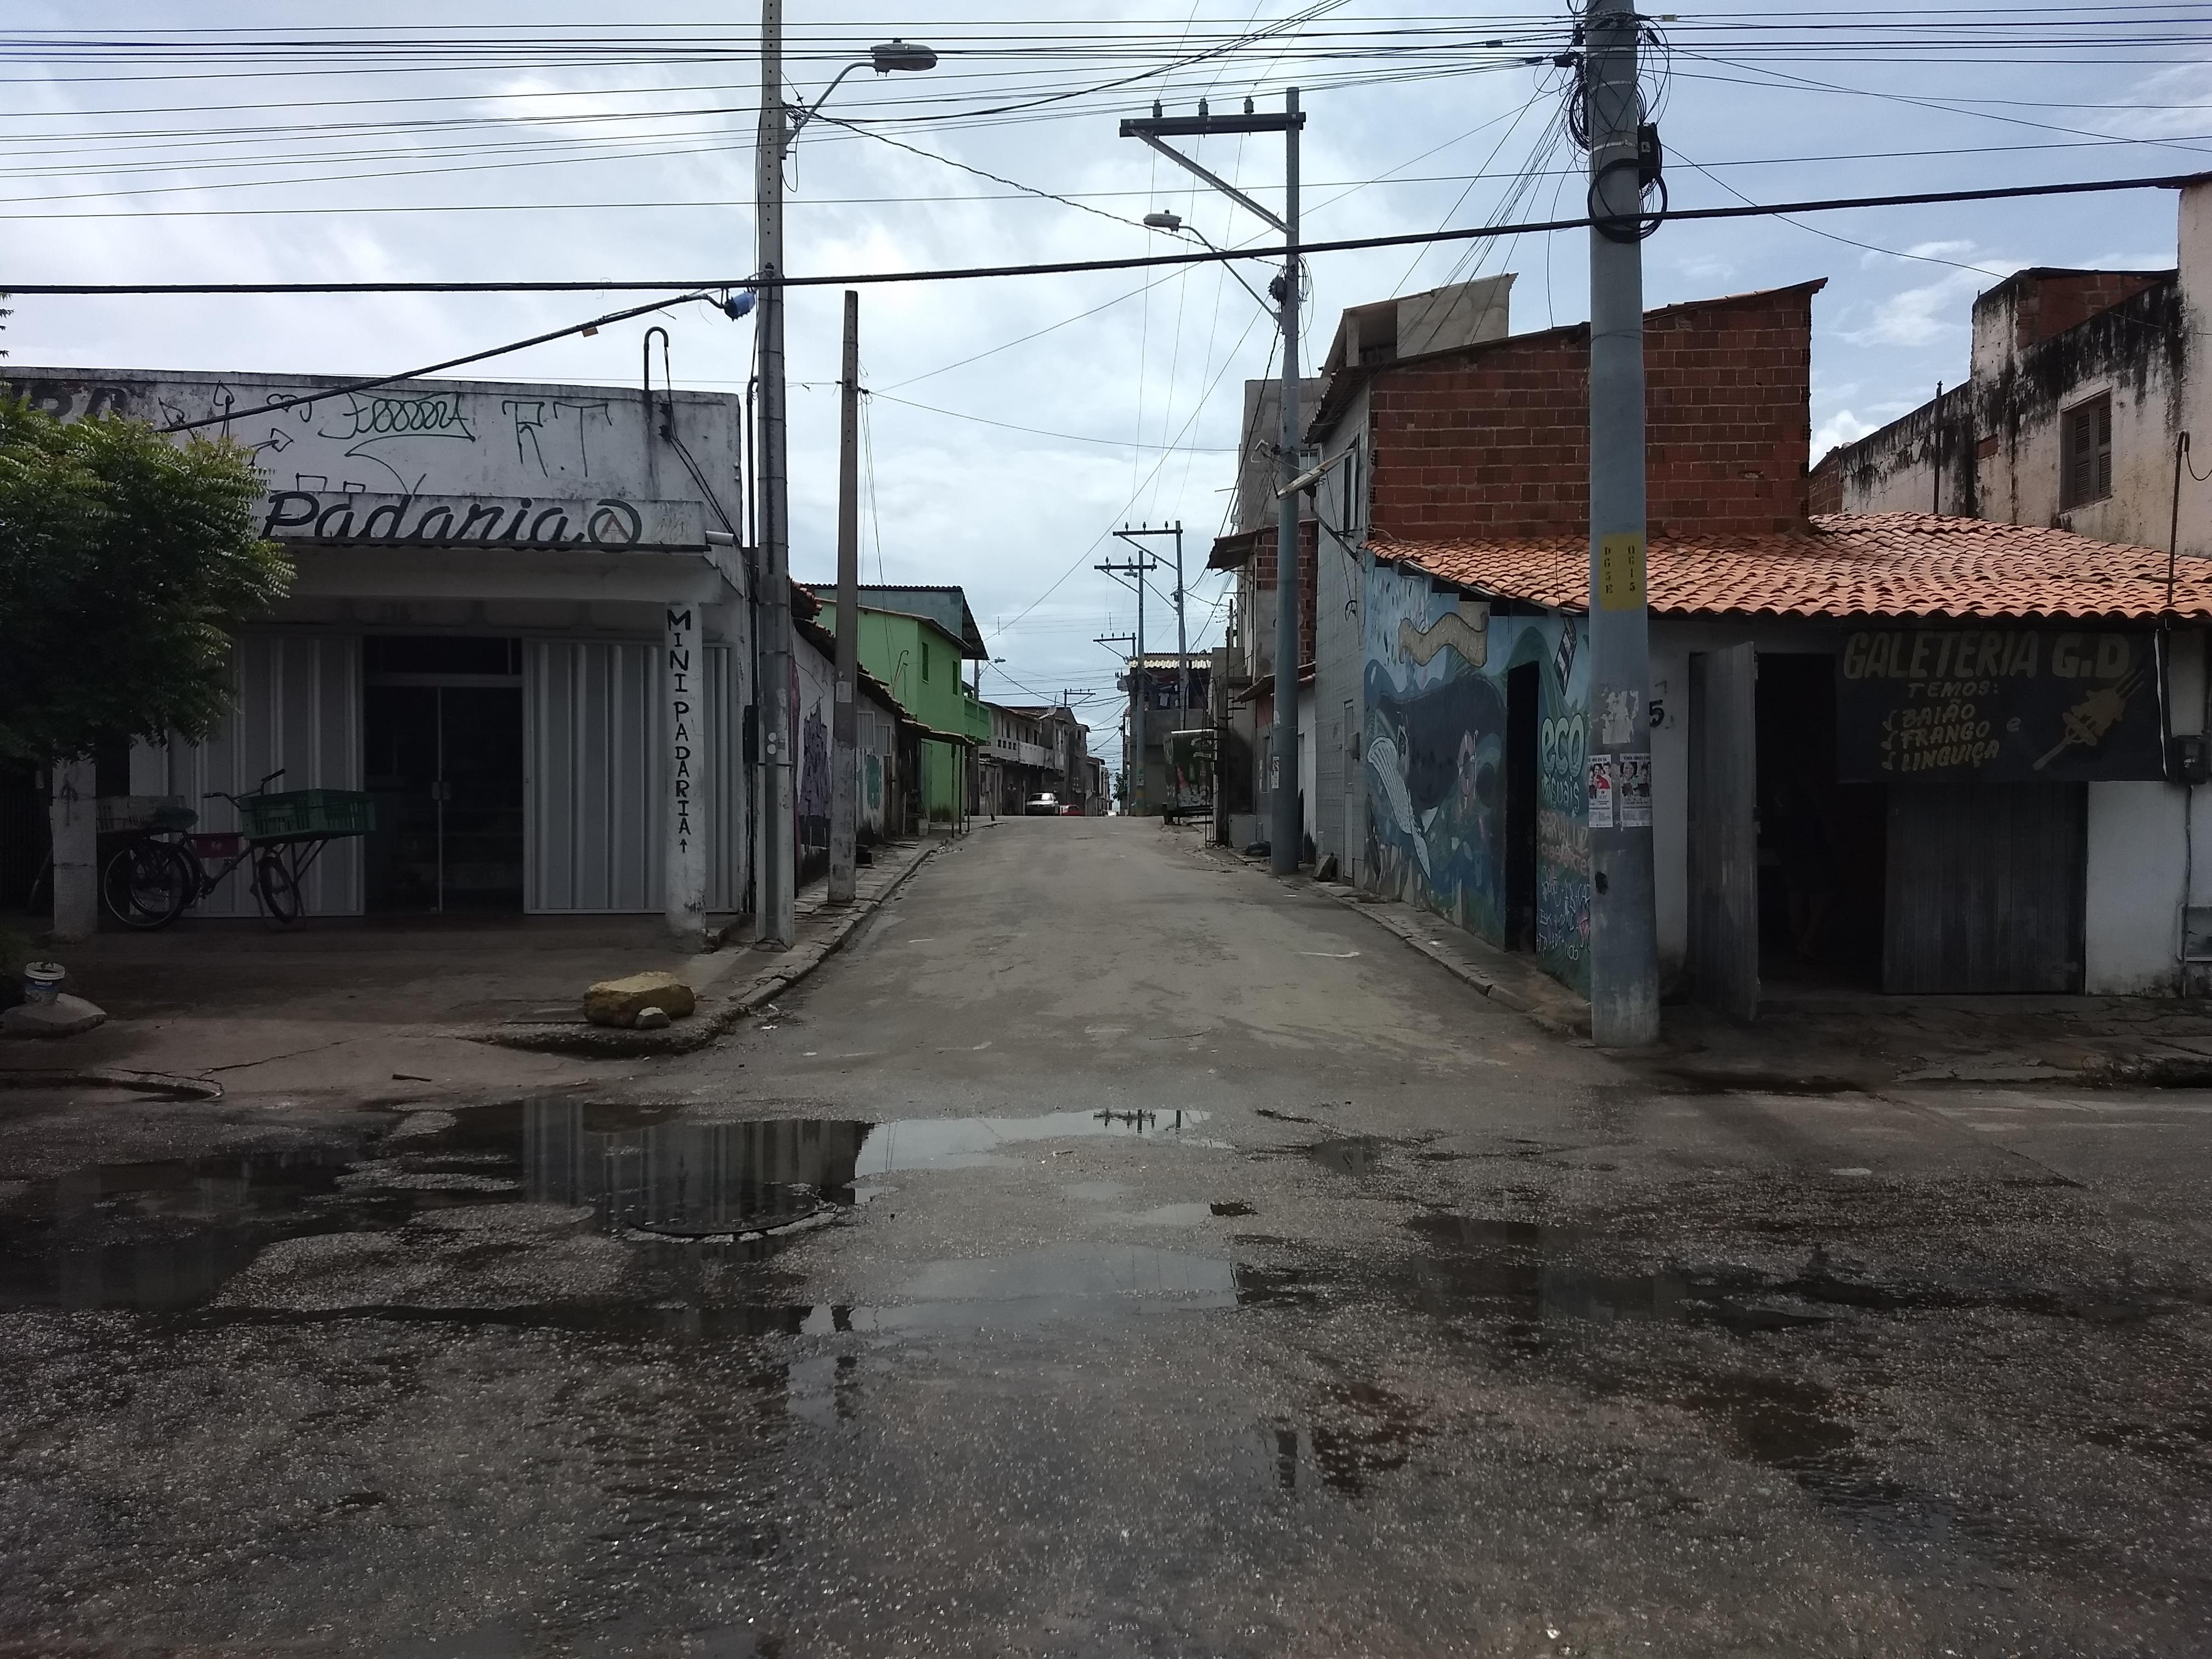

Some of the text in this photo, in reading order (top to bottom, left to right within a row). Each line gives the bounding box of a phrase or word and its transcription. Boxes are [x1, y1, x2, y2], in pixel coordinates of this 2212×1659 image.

[260, 490, 585, 548] Padaria
[1843, 630, 2131, 679] GALETERIA G.D
[1908, 681, 2000, 698] TEMOS:
[667, 609, 691, 836] MINI PADARIA
[1902, 698, 1976, 727] BAIÃO
[1900, 716, 2022, 750] FRANGO e
[1900, 739, 2000, 772] LINGUIÇA
